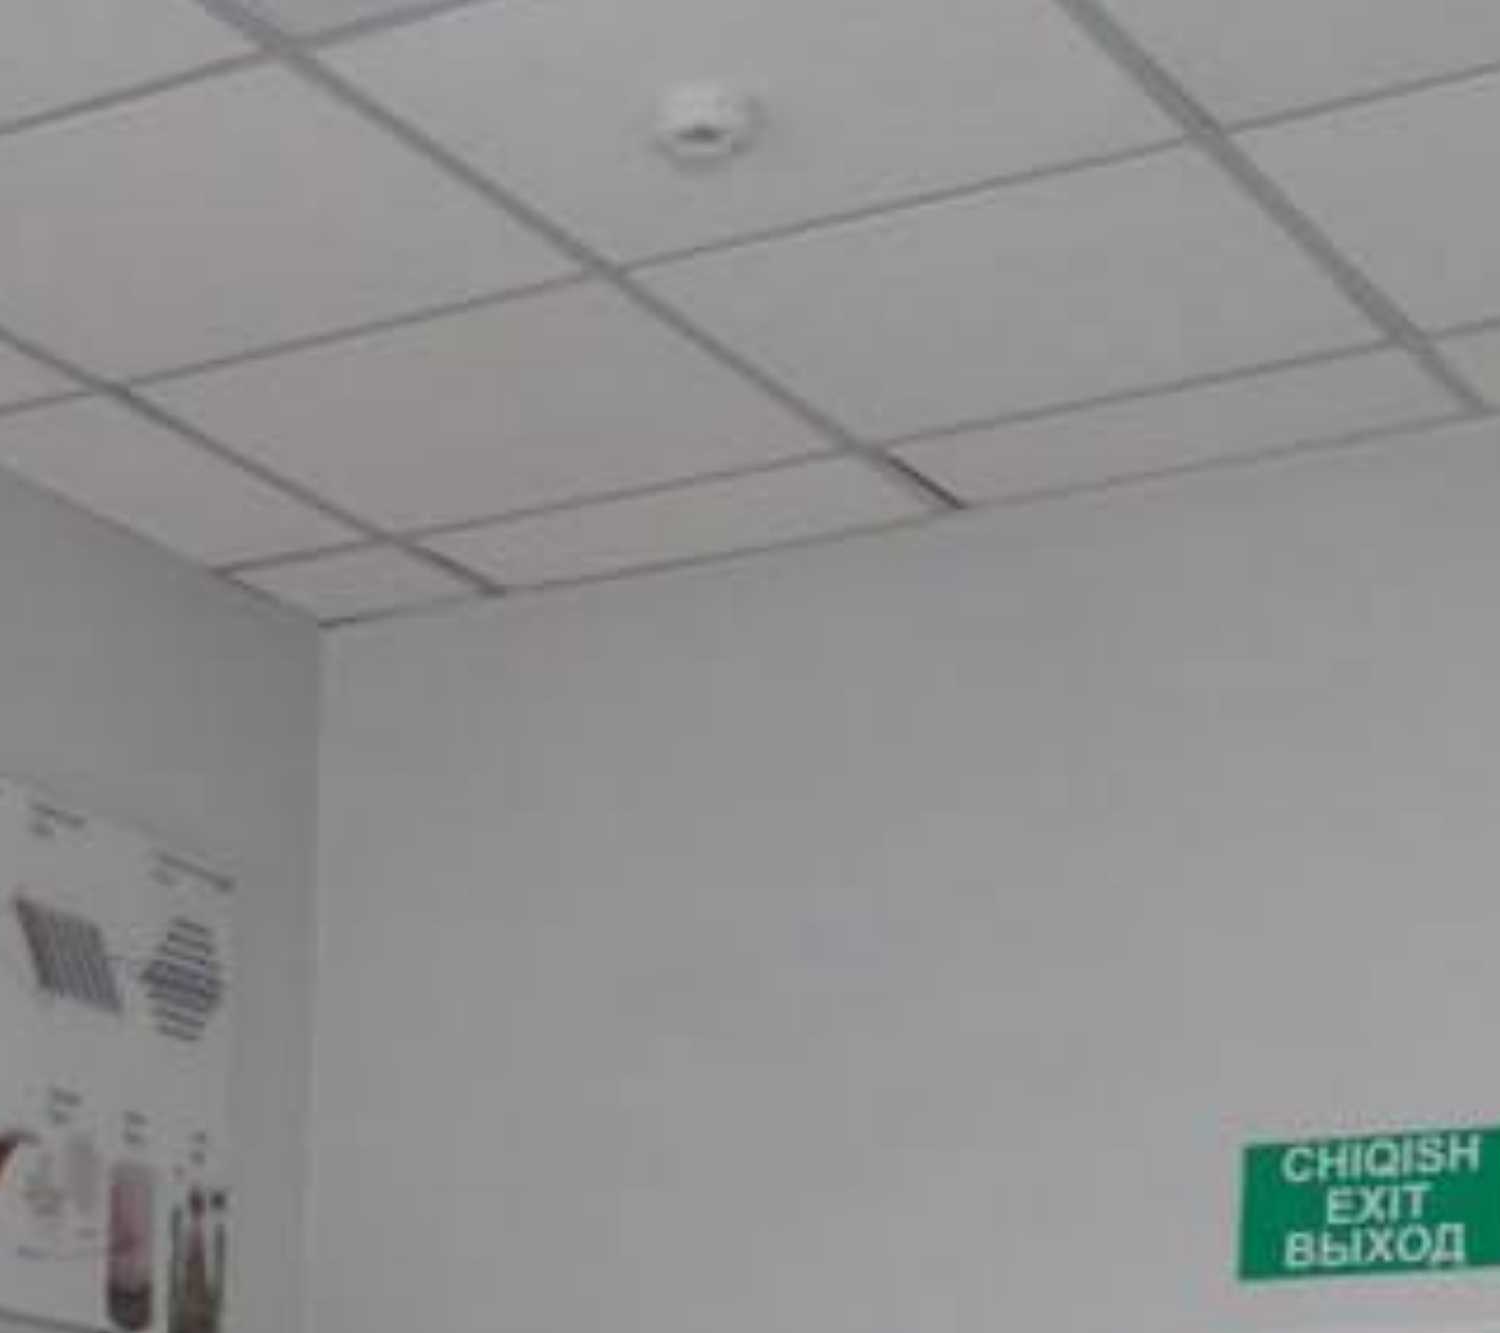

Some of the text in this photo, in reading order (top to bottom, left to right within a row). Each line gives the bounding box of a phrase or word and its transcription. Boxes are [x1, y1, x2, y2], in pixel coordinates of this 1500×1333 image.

[1280, 1134, 1481, 1183] CHIQISH
[1326, 1181, 1431, 1225] EXIT
[1284, 1222, 1466, 1269] ВЫХОД
